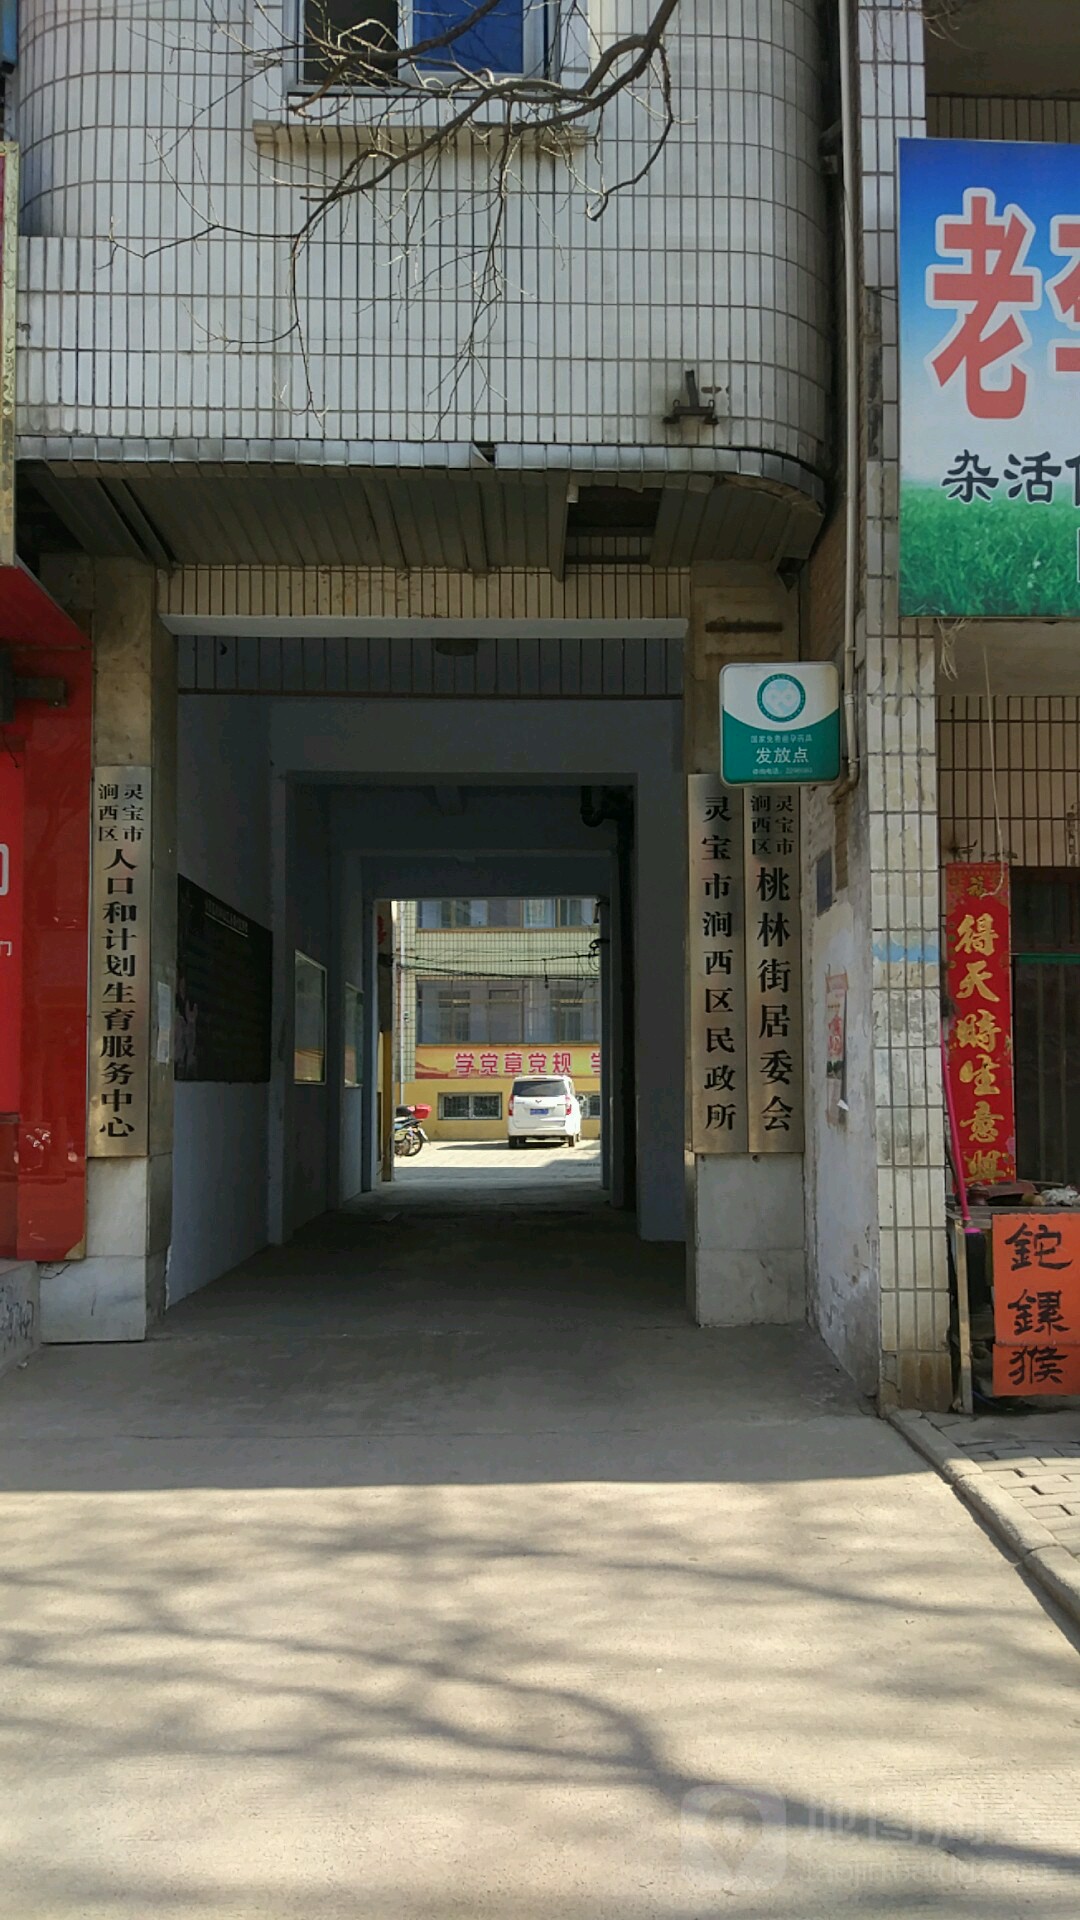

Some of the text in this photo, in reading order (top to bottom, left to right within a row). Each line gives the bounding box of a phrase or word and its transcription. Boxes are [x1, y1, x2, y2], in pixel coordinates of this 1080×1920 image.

[755, 747, 809, 764] 发放点
[97, 783, 119, 842] 涧西区
[122, 783, 145, 843] 灵宝市
[750, 795, 771, 856] 涧西区
[774, 795, 795, 856] 灵宝市
[98, 848, 137, 1138] 人口和计划生育服务中心
[701, 796, 737, 1132] 灵宝市涧西区民政所
[755, 866, 795, 1132] 桃林街居委会
[455, 1052, 572, 1076] 学党章党规
